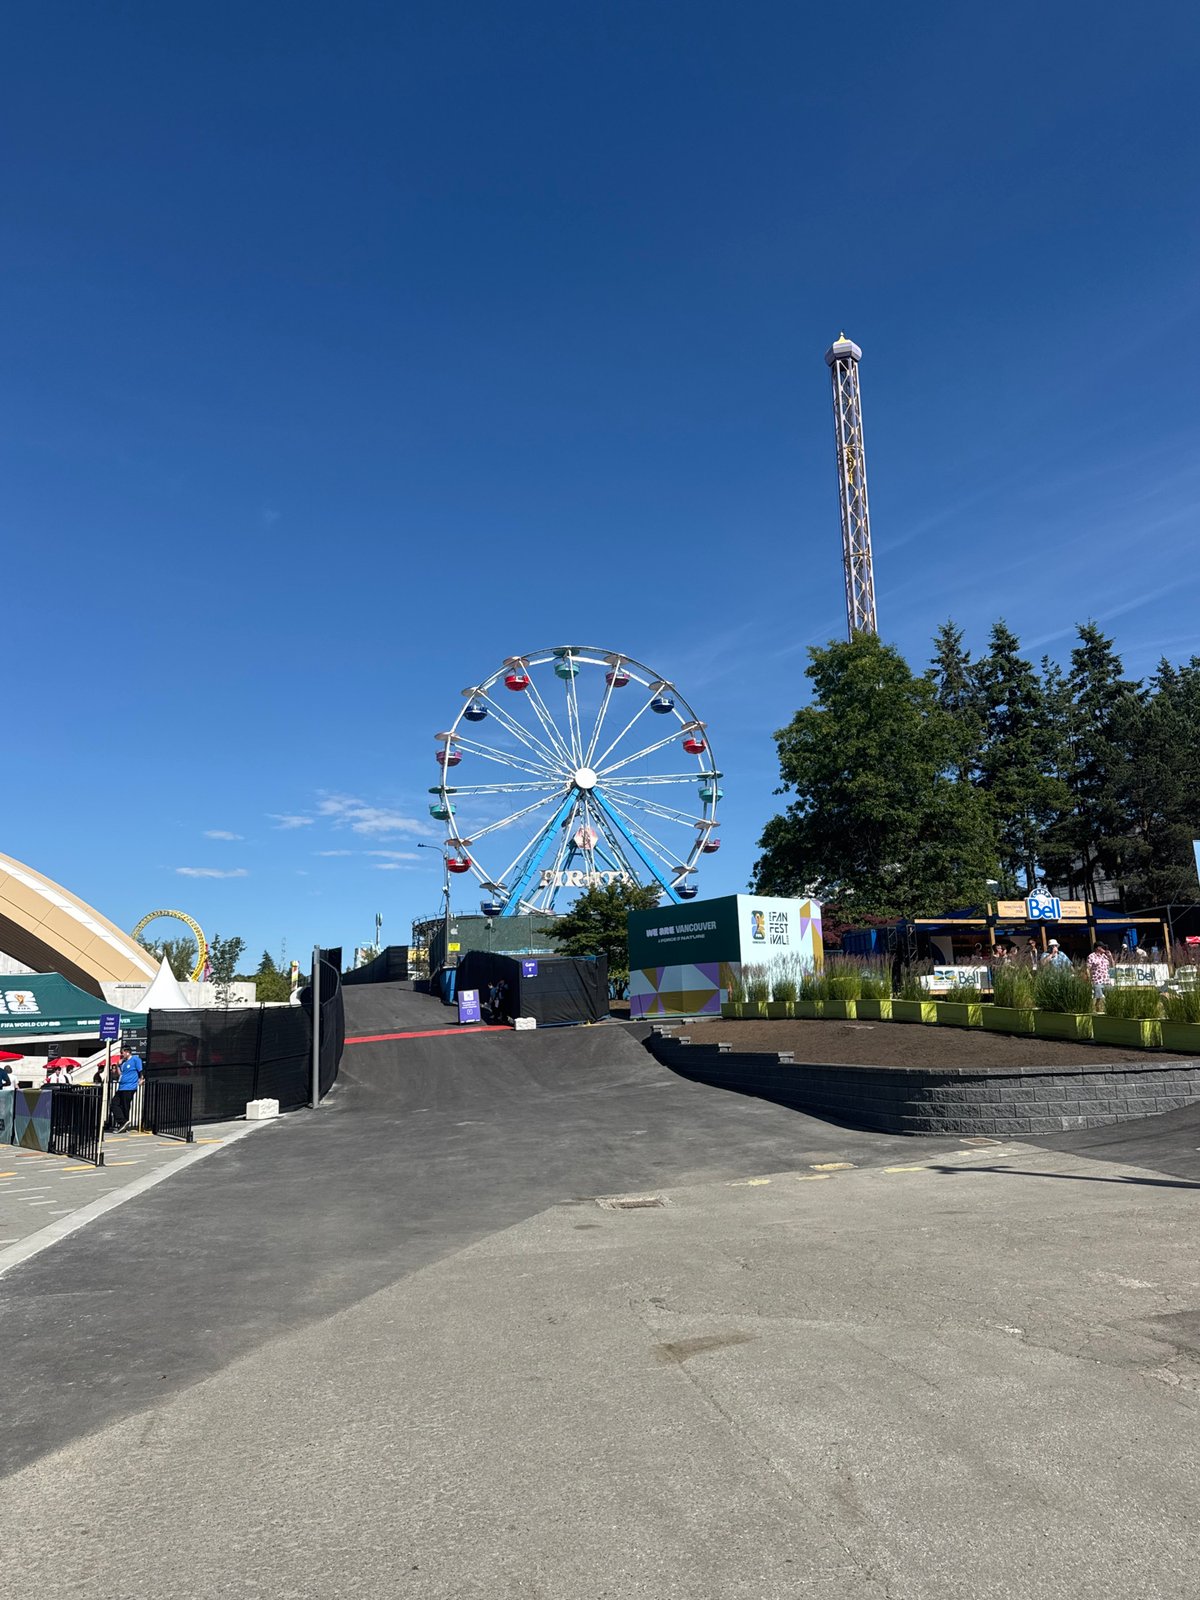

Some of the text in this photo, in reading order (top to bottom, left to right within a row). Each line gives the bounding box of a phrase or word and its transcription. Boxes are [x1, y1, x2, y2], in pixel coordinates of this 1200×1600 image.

[1028, 898, 1061, 919] Bell
[772, 911, 788, 922] FAN
[646, 928, 658, 938] WE
[675, 920, 717, 933] VANCOUVER
[769, 923, 788, 934] FEST
[958, 971, 979, 984] Bell
[1136, 968, 1156, 981] Bell
